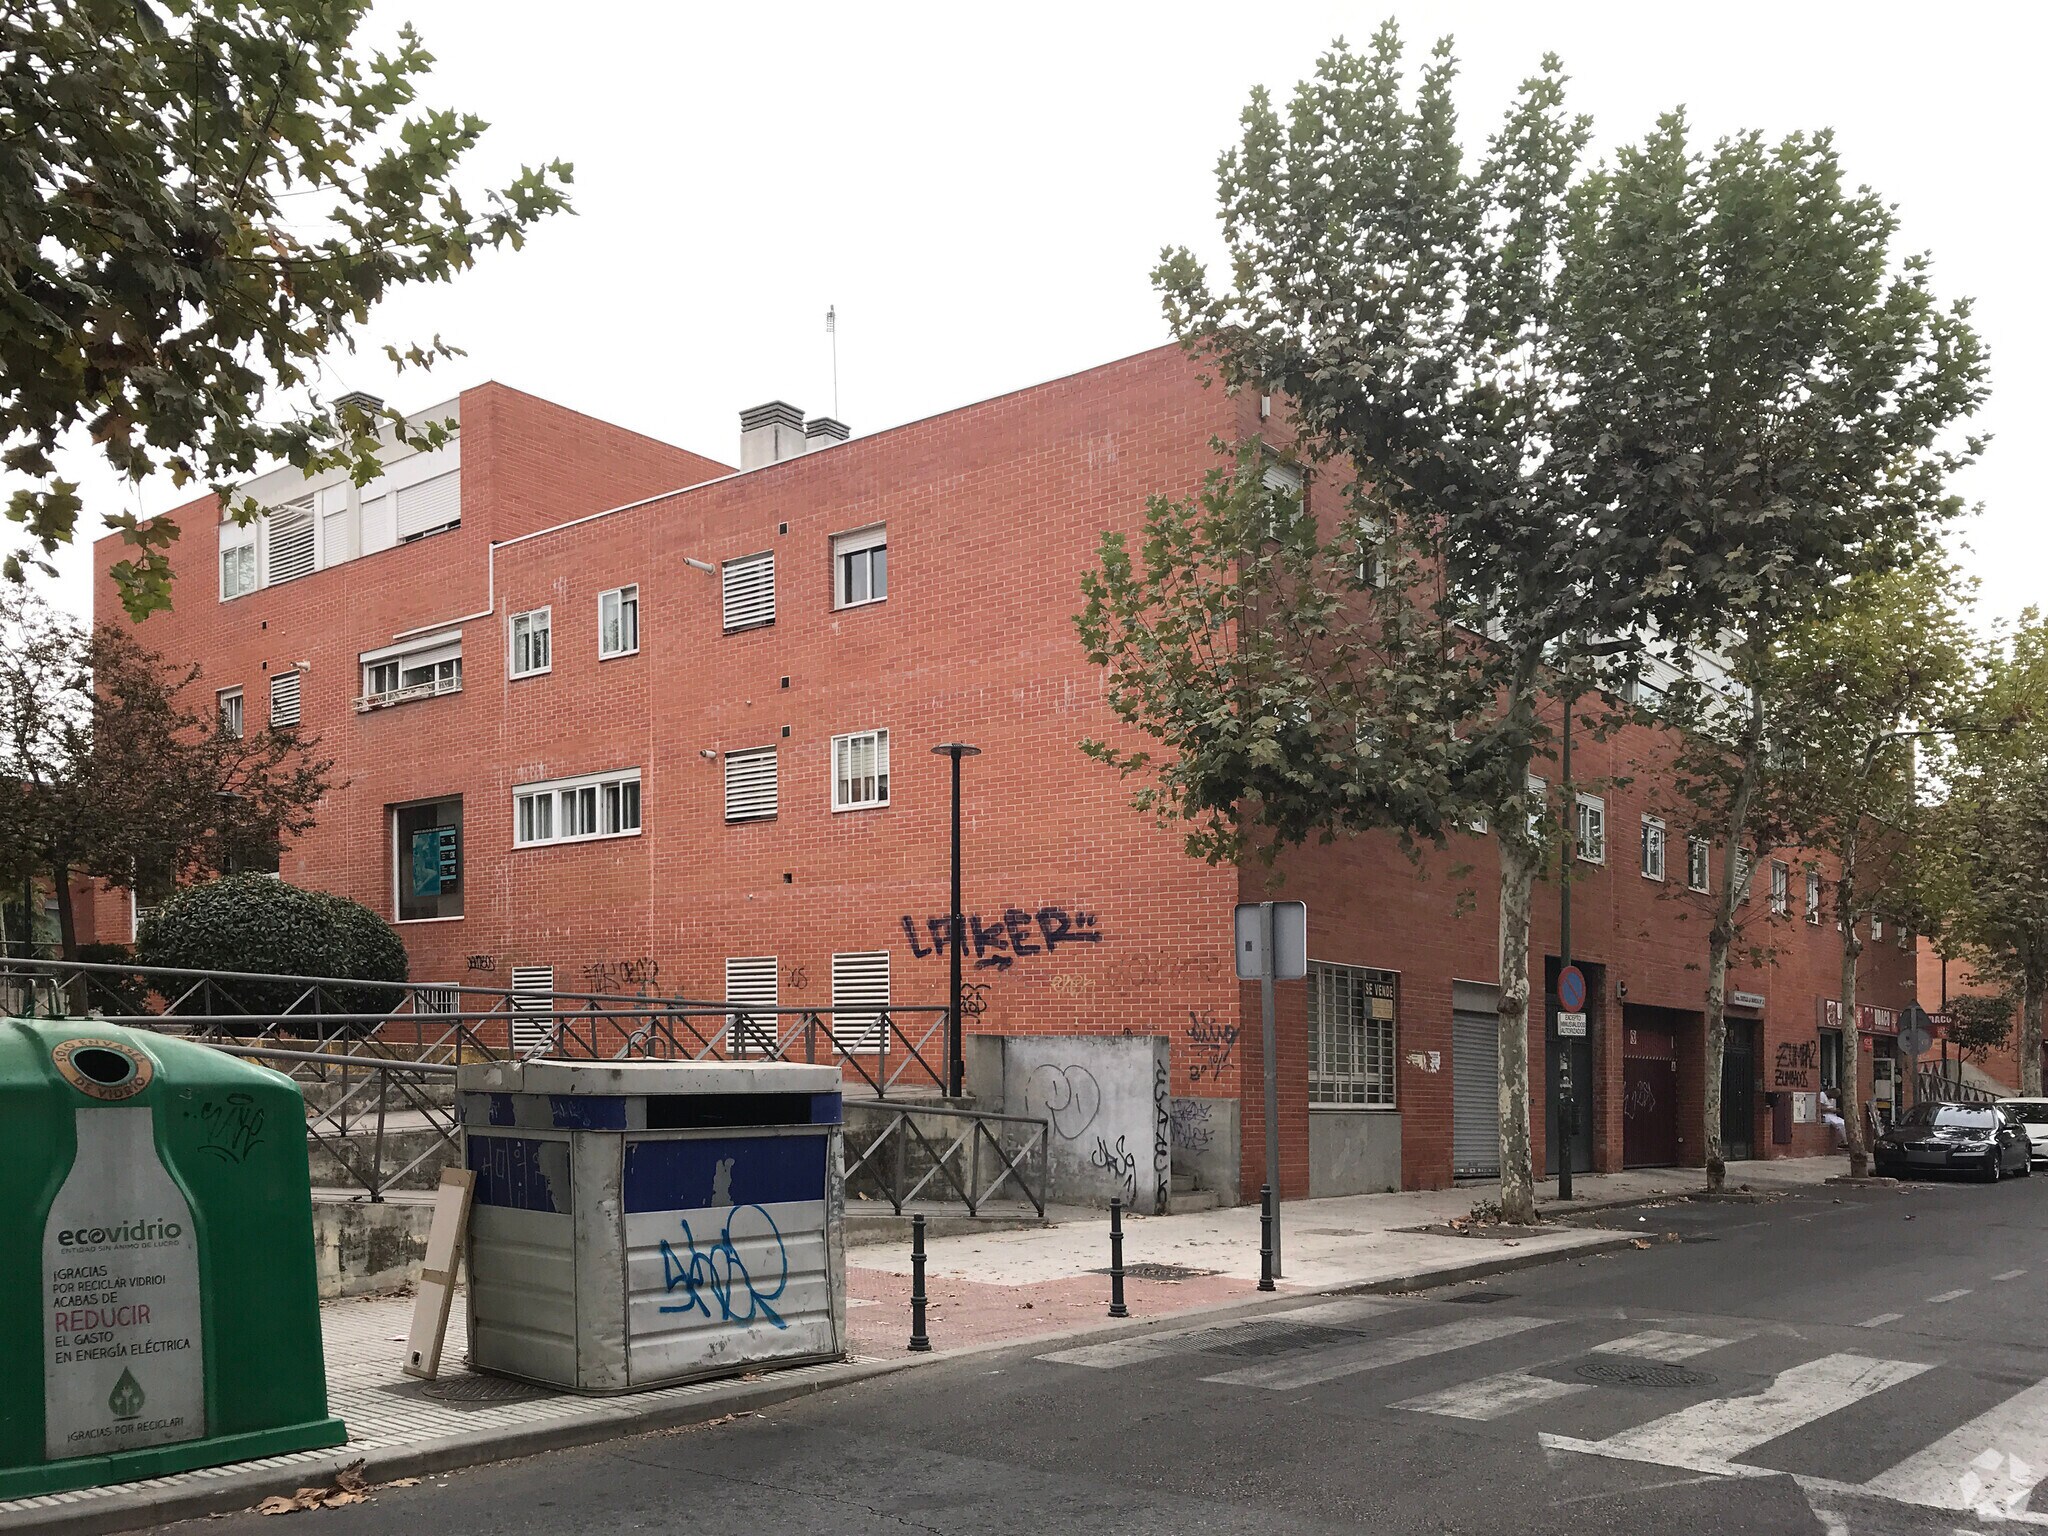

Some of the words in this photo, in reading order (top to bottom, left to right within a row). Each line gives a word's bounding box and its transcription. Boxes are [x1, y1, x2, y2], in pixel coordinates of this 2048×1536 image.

[1365, 982, 1373, 995] SE
[1374, 983, 1394, 998] VENDE
[56, 1043, 75, 1062] SOLO
[79, 1040, 145, 1062] ENVASES
[73, 1077, 93, 1092] DE
[98, 1077, 145, 1099] VIDRIO
[58, 1217, 182, 1246] ecovidrio
[61, 1246, 96, 1254] ENTIDAD
[142, 1241, 151, 1249] DE
[154, 1240, 179, 1248] LUCRO
[53, 1265, 108, 1282] ¡GRACIAS
[53, 1283, 74, 1294] POR
[53, 1294, 98, 1308] ACABAS
[102, 1292, 118, 1304] DE
[56, 1304, 151, 1332] REDUCIR
[55, 1336, 70, 1348] EL
[74, 1332, 114, 1345] GASTO
[55, 1352, 72, 1364] EN
[76, 1343, 127, 1361] ENERGÍA
[130, 1339, 190, 1355] ELÉCTRICA
[115, 1424, 134, 1435] POR
